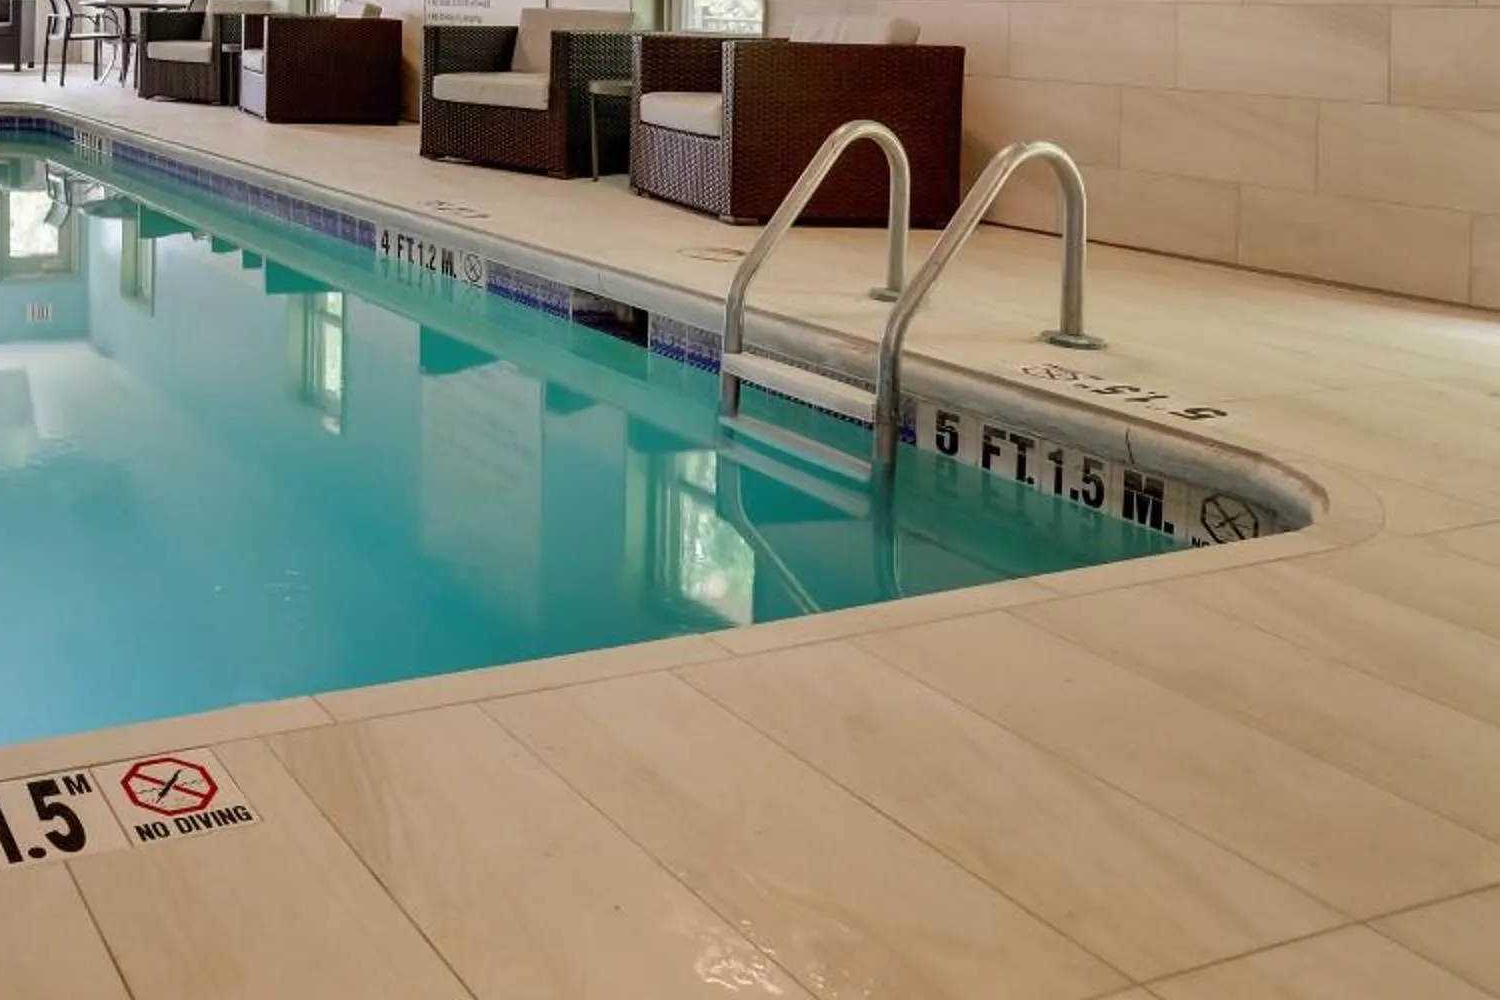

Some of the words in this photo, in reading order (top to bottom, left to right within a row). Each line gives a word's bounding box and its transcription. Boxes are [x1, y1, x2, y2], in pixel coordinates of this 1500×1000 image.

[381, 229, 390, 256] 4
[935, 410, 961, 456] 5
[981, 424, 1036, 486] FT.
[1047, 449, 1106, 509] 1.5
[1122, 469, 1175, 535] M.
[62, 773, 93, 796] M
[134, 821, 171, 842] NO
[173, 805, 253, 834] DIVING
